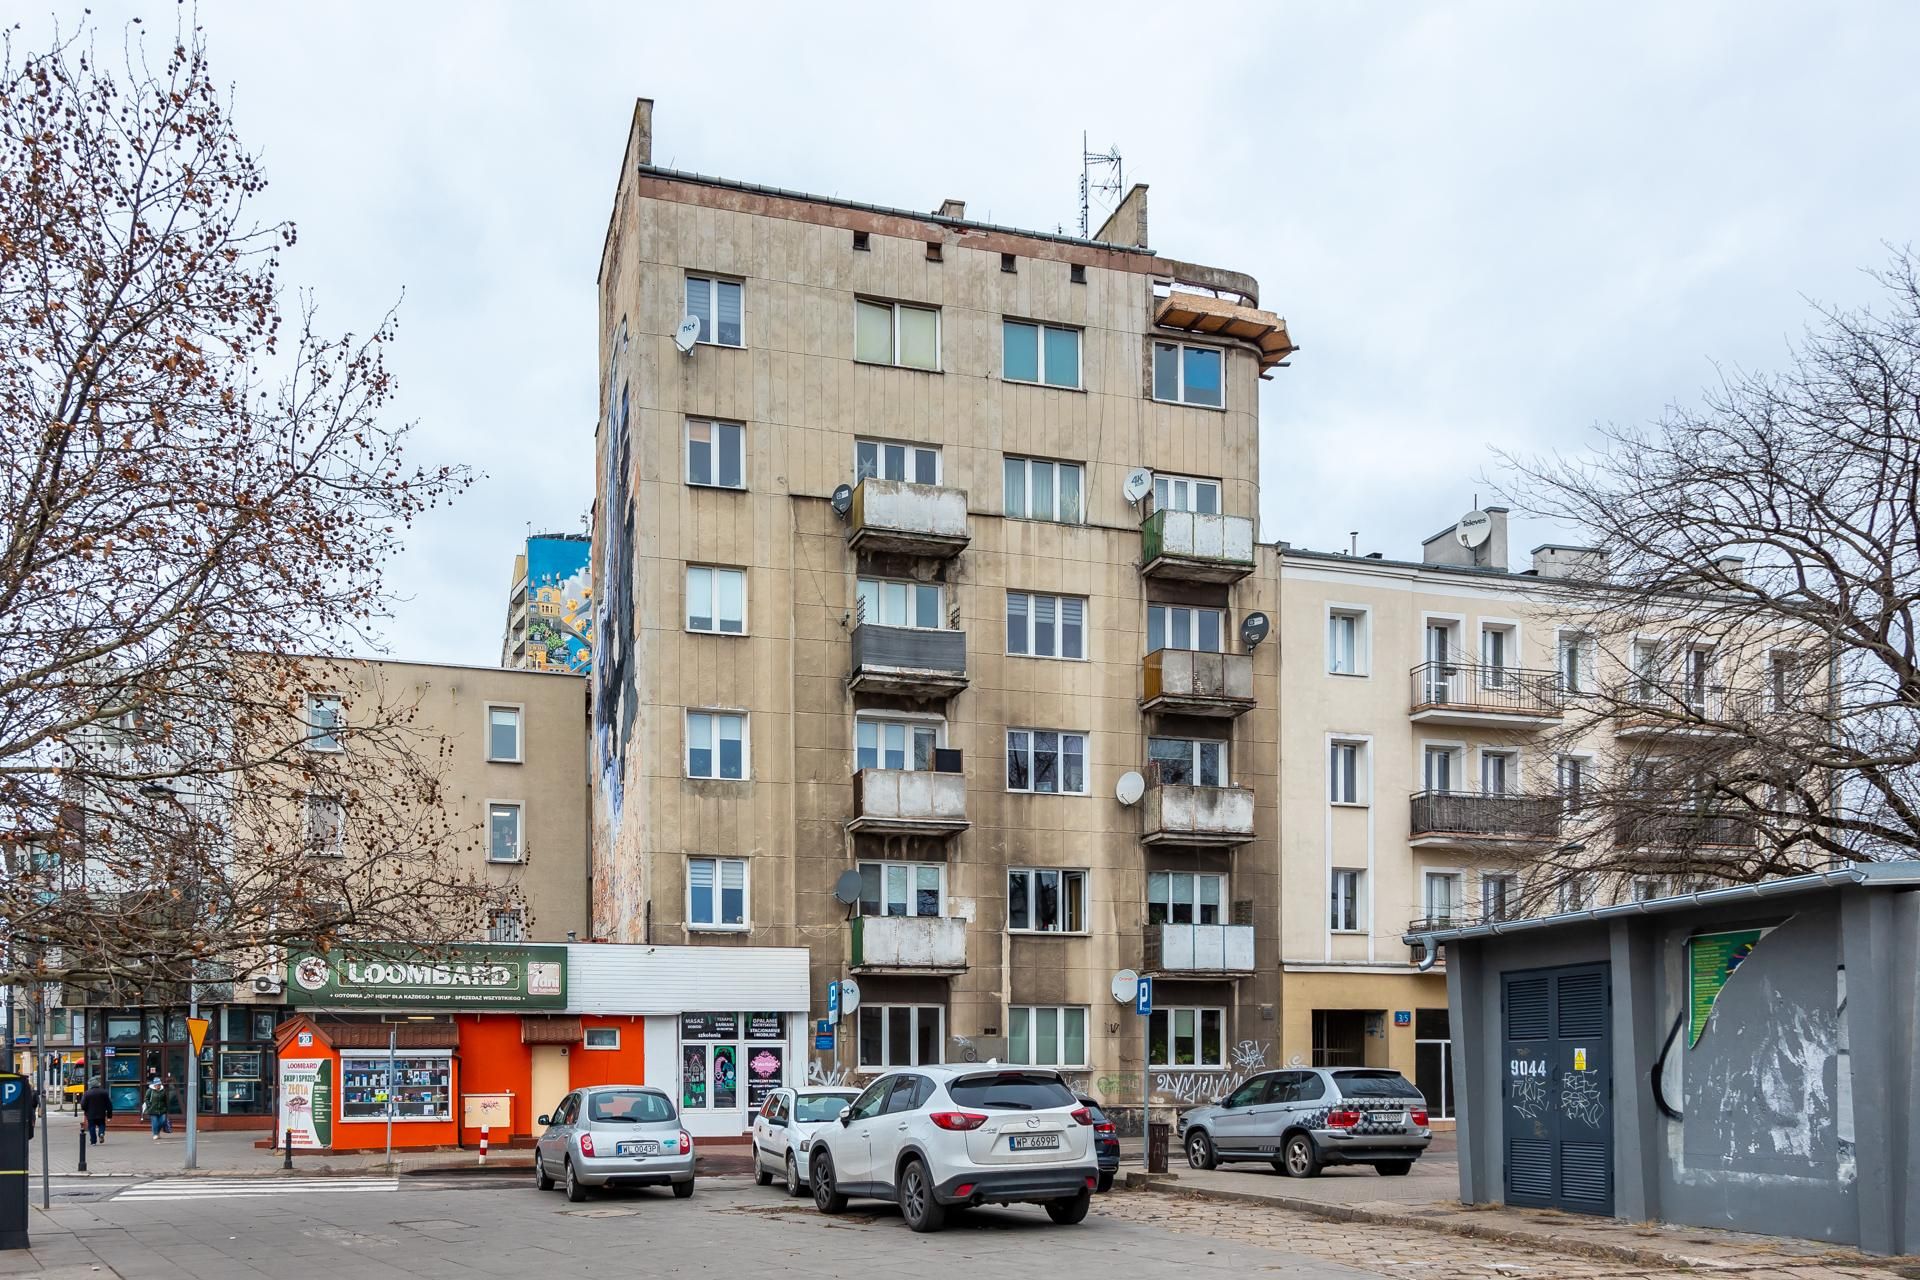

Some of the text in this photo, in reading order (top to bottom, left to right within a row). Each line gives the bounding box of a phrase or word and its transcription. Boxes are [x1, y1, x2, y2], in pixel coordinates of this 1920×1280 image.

[1131, 473, 1144, 484] 4K
[1462, 517, 1487, 527] Televes
[348, 961, 511, 986] LOOMBARD
[1140, 982, 1148, 1011] P
[1511, 1060, 1547, 1077] 9044
[283, 1074, 296, 1082] SKUP
[5, 1083, 16, 1099] P
[1015, 1136, 1057, 1147] WP 6699P
[634, 1145, 657, 1154] 0043P
